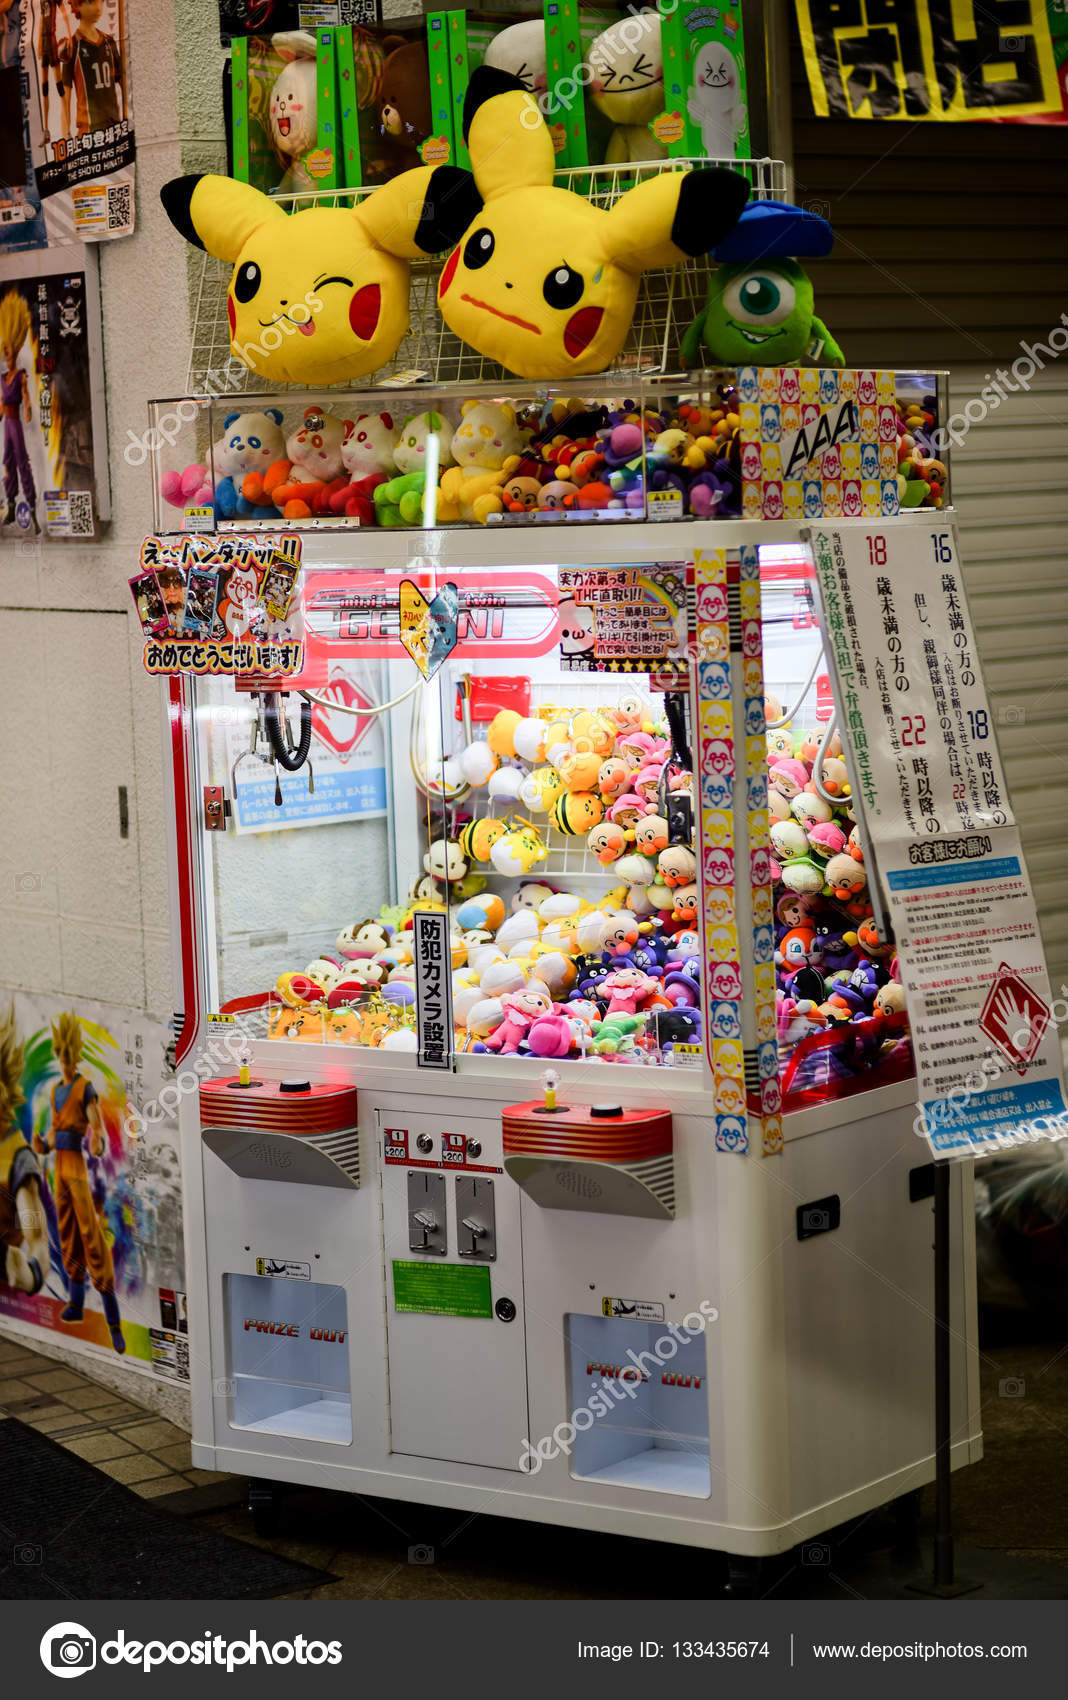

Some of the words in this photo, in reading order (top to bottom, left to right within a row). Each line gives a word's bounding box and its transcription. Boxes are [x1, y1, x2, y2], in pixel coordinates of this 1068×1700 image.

[91, 61, 111, 89] 10
[52, 120, 128, 163] 10月上旬登場予定
[67, 155, 89, 170] MASTER
[91, 147, 115, 162] STARS
[67, 172, 78, 181] THE
[78, 164, 102, 177] SHOYO
[103, 156, 124, 171] HINATA
[785, 399, 856, 478] AAA
[866, 535, 888, 566] 18
[931, 534, 952, 563] 16
[339, 608, 504, 639] GENI
[876, 577, 910, 692] 歳未満の方の
[941, 574, 976, 687] 歳未満の方の
[901, 714, 926, 746] 22
[967, 709, 989, 740] 18
[912, 757, 940, 833] 時以降の
[977, 751, 1007, 825] 時以降の
[909, 835, 992, 864] お客様にお願い
[420, 919, 445, 1063] 防犯カメラ設置
[244, 1319, 300, 1338] PRIZE
[310, 1327, 349, 1343] OUT
[662, 1371, 706, 1389] OUT
